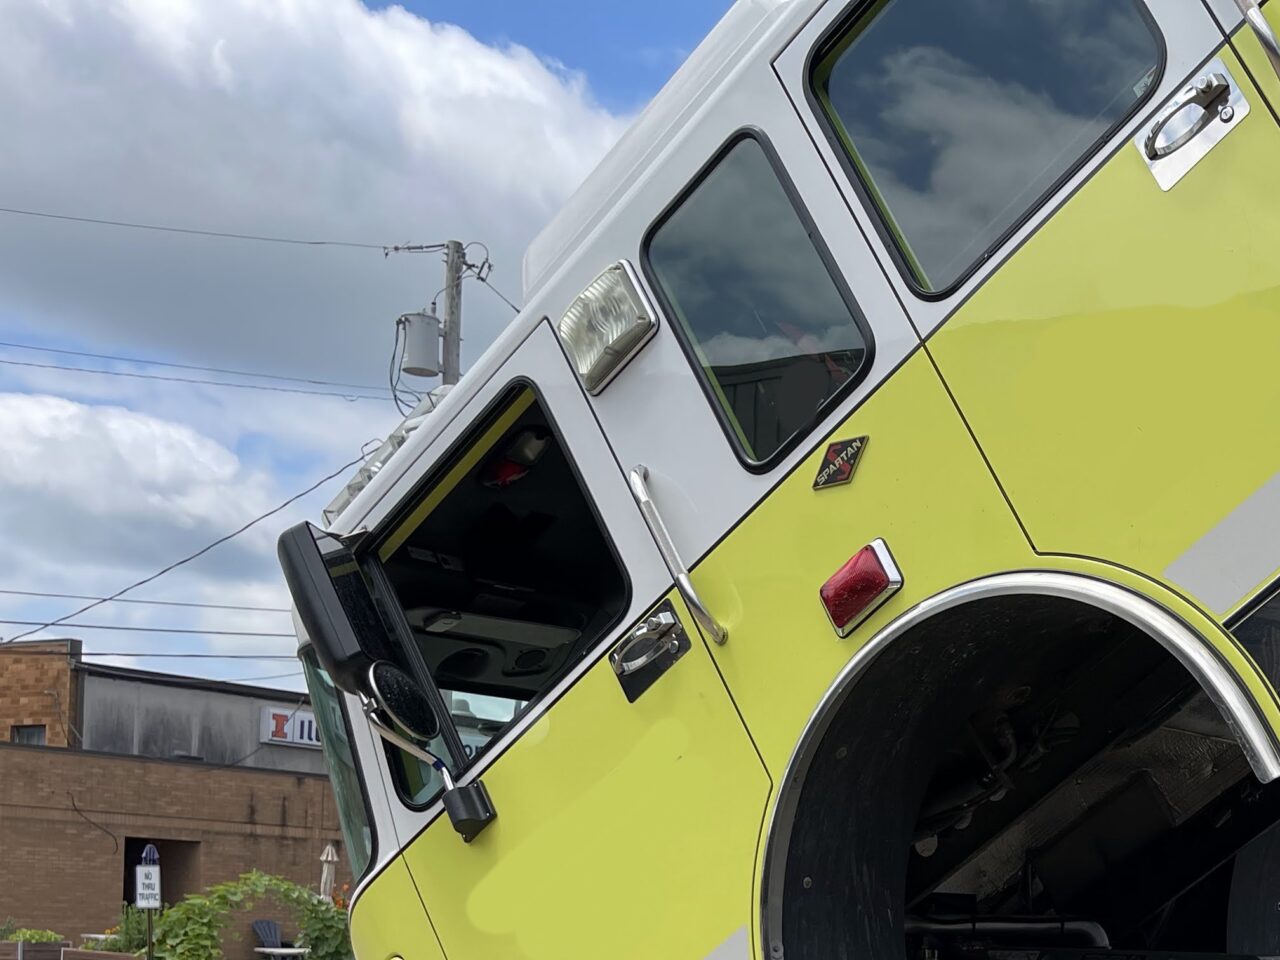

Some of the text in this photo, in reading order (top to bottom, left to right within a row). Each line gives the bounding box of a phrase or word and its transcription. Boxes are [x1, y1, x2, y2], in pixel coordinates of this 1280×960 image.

[817, 439, 862, 486] SPARTAN
[144, 871, 153, 881] NO
[142, 882, 156, 891] THRU
[138, 892, 159, 901] TRAFFIC
